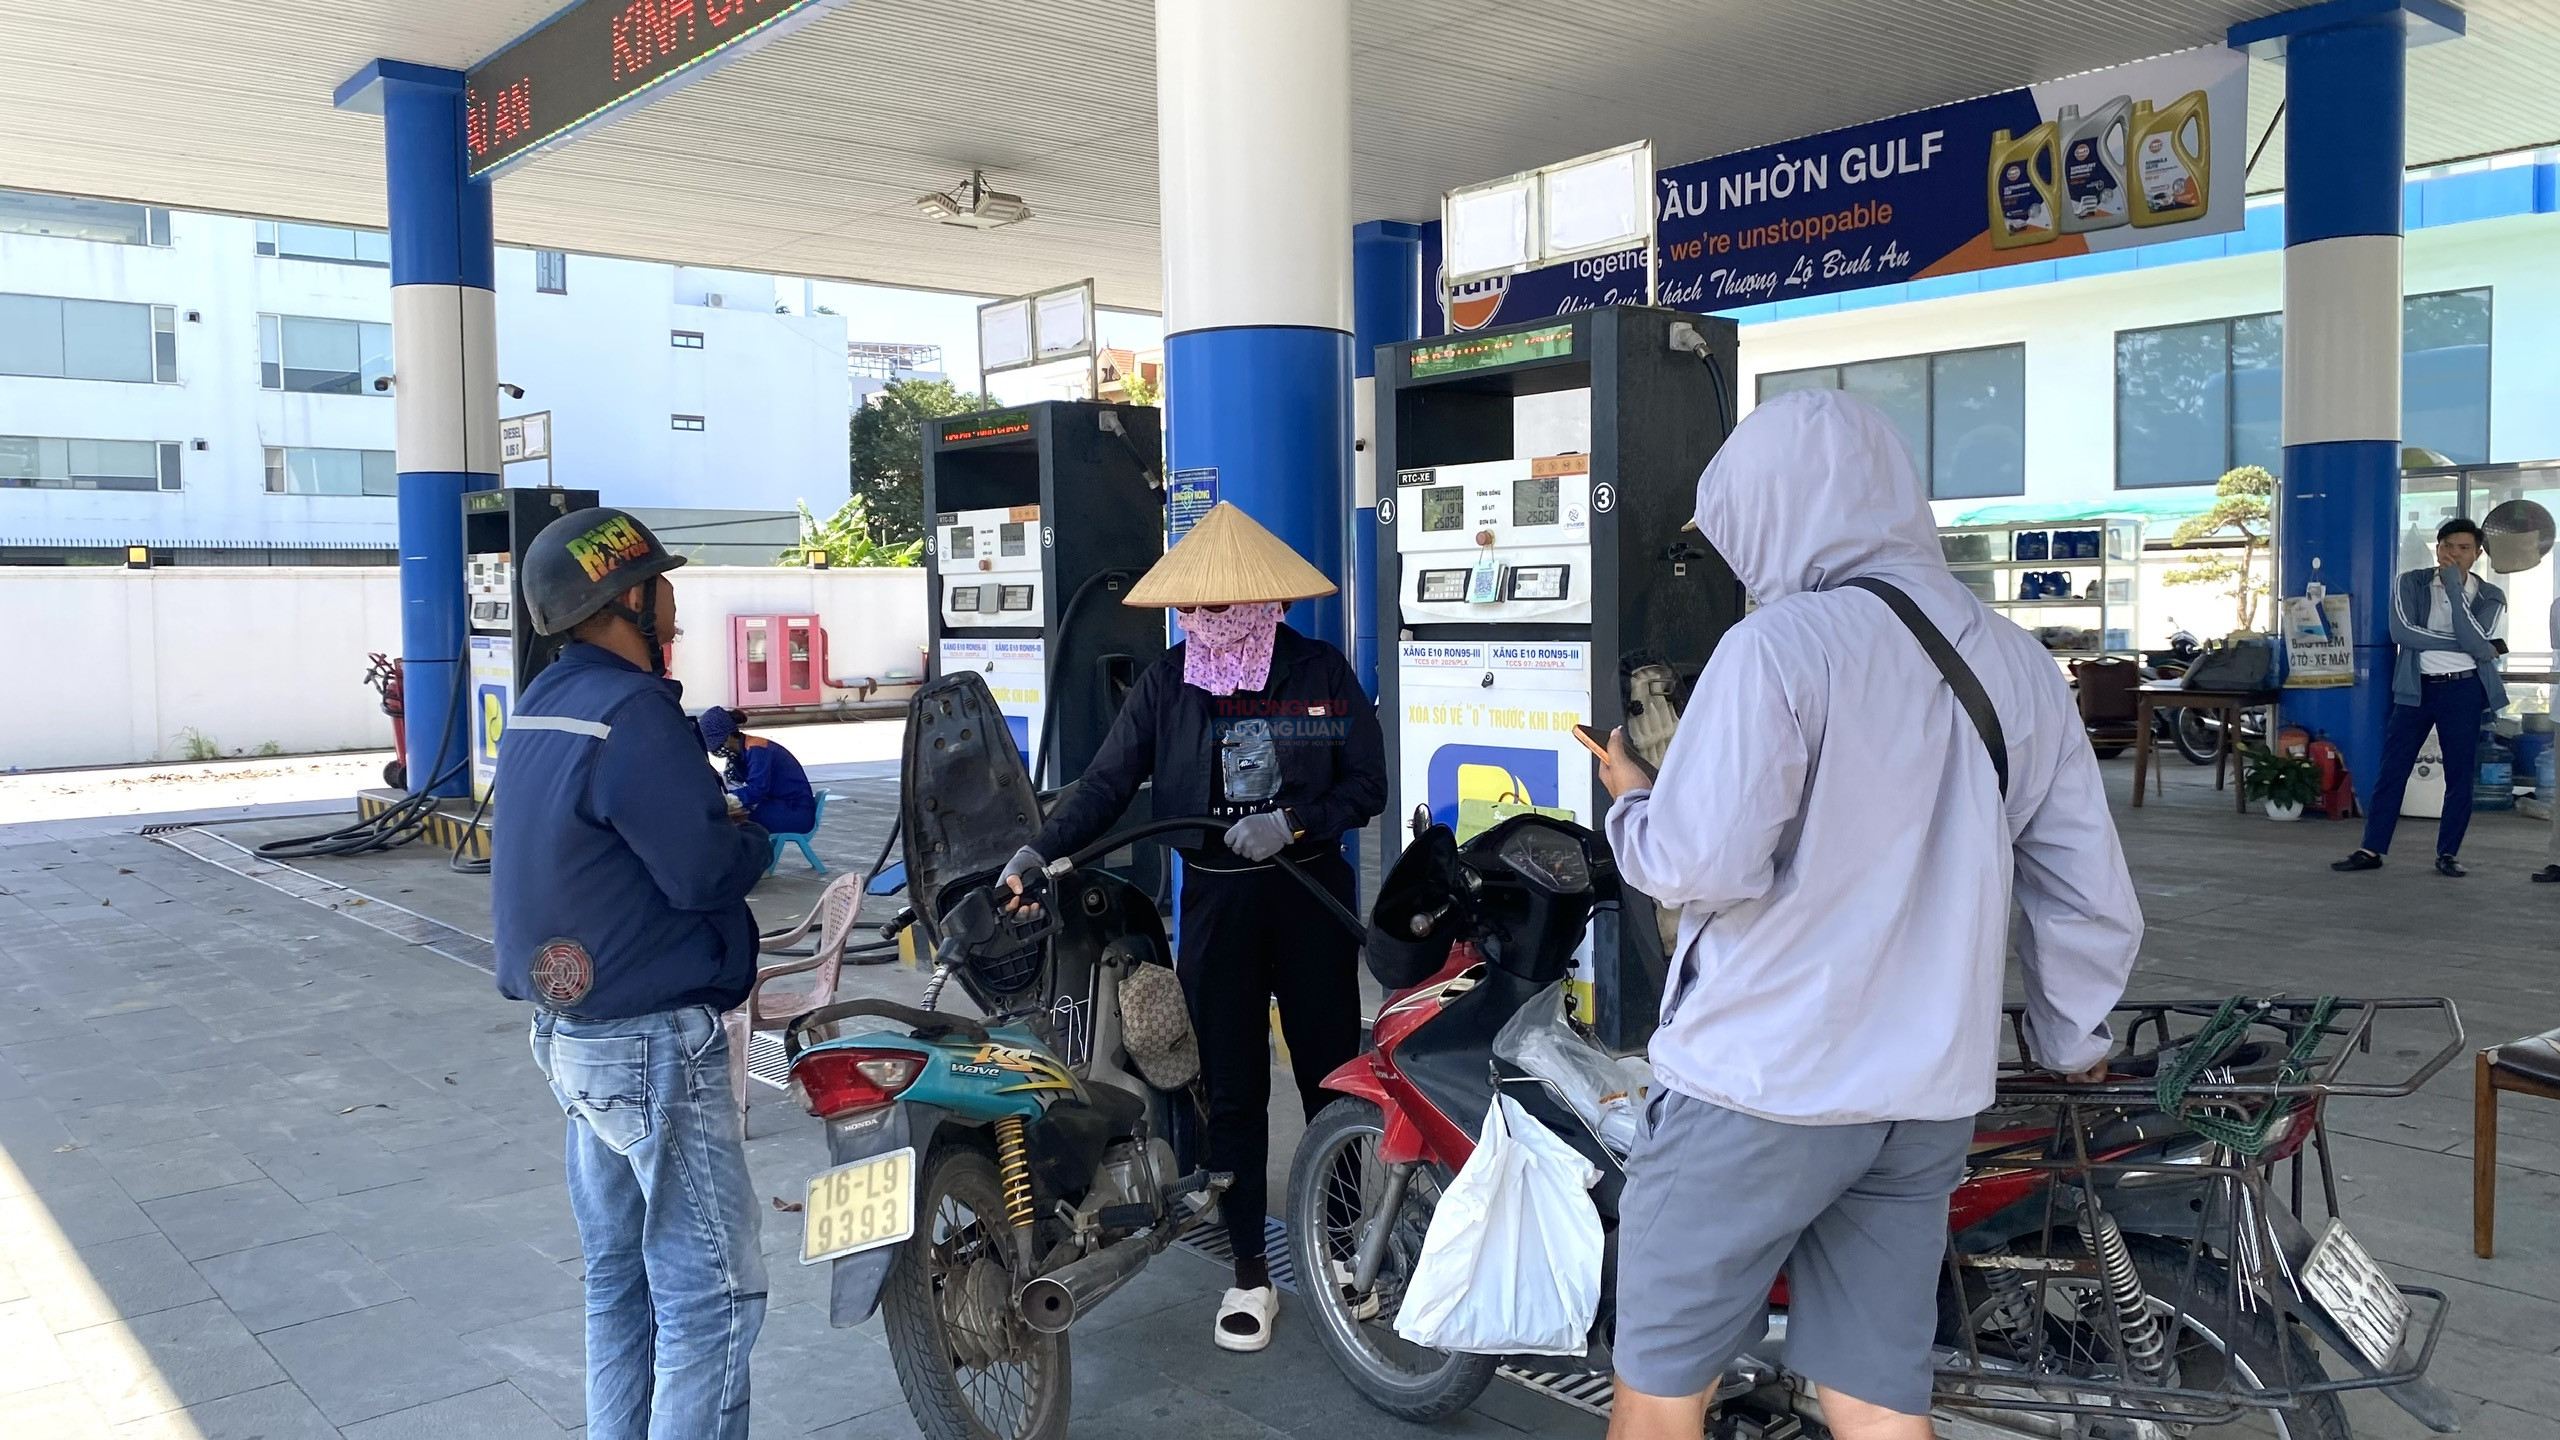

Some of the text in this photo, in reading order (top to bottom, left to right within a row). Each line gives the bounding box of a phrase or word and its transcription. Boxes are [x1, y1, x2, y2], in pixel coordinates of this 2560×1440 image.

[1656, 130, 1944, 222] ẦU NHỜN GULF
[1670, 231, 1731, 262] we're
[1738, 199, 1893, 250] unstoppable
[1785, 255, 1815, 290] Lộ
[1822, 249, 1871, 281] Bình
[1878, 240, 1911, 273] An
[1402, 472, 1431, 483] RTC-XE
[1597, 486, 1611, 509] 3
[1381, 502, 1392, 520] 4
[928, 539, 935, 552] 6
[1044, 529, 1052, 546] 5
[1403, 645, 1481, 658] XĂNG E10 RON95-III
[1493, 646, 1579, 659] XĂNG E10 RON95-III
[2315, 654, 2327, 666] XE
[1408, 702, 1430, 724] XÓA
[1489, 706, 1525, 729] TRƯỚC
[1529, 710, 1548, 730] KHI
[844, 1118, 878, 1132] HONDA
[824, 1158, 898, 1210] 16-L9
[818, 1199, 897, 1250] 9393
